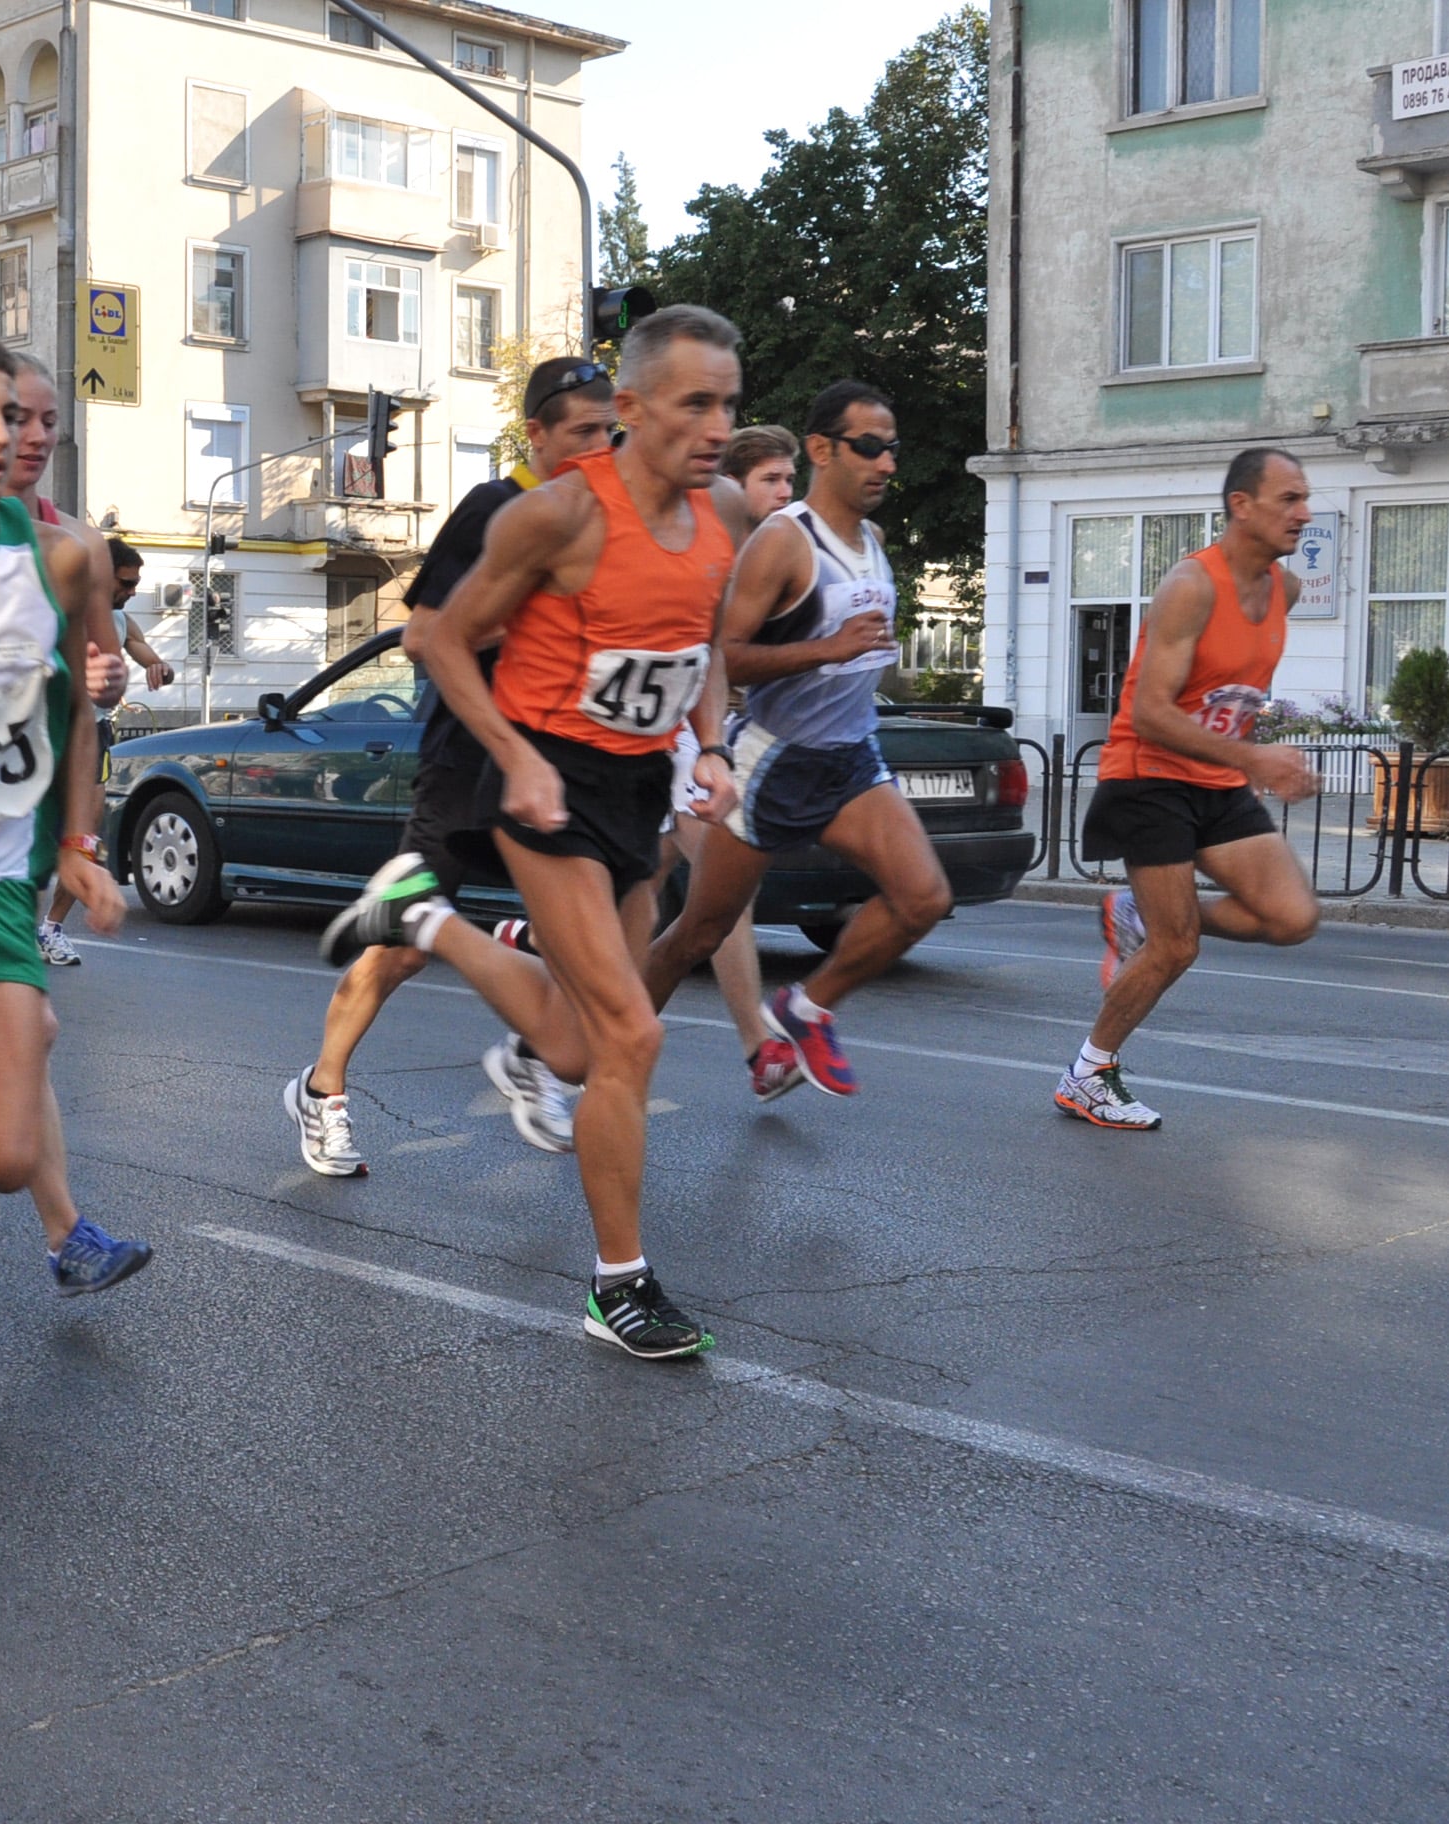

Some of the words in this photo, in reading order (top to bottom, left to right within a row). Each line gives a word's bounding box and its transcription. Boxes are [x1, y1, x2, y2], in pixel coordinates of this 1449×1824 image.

[1402, 62, 1449, 85] ПРОДАВ
[1403, 90, 1428, 110] 0896
[1432, 87, 1444, 104] 76
[1299, 527, 1332, 540] ПТЕКА
[1300, 574, 1332, 589] ЕЧЕВ
[594, 657, 699, 728] 457
[921, 772, 950, 795] 1177
